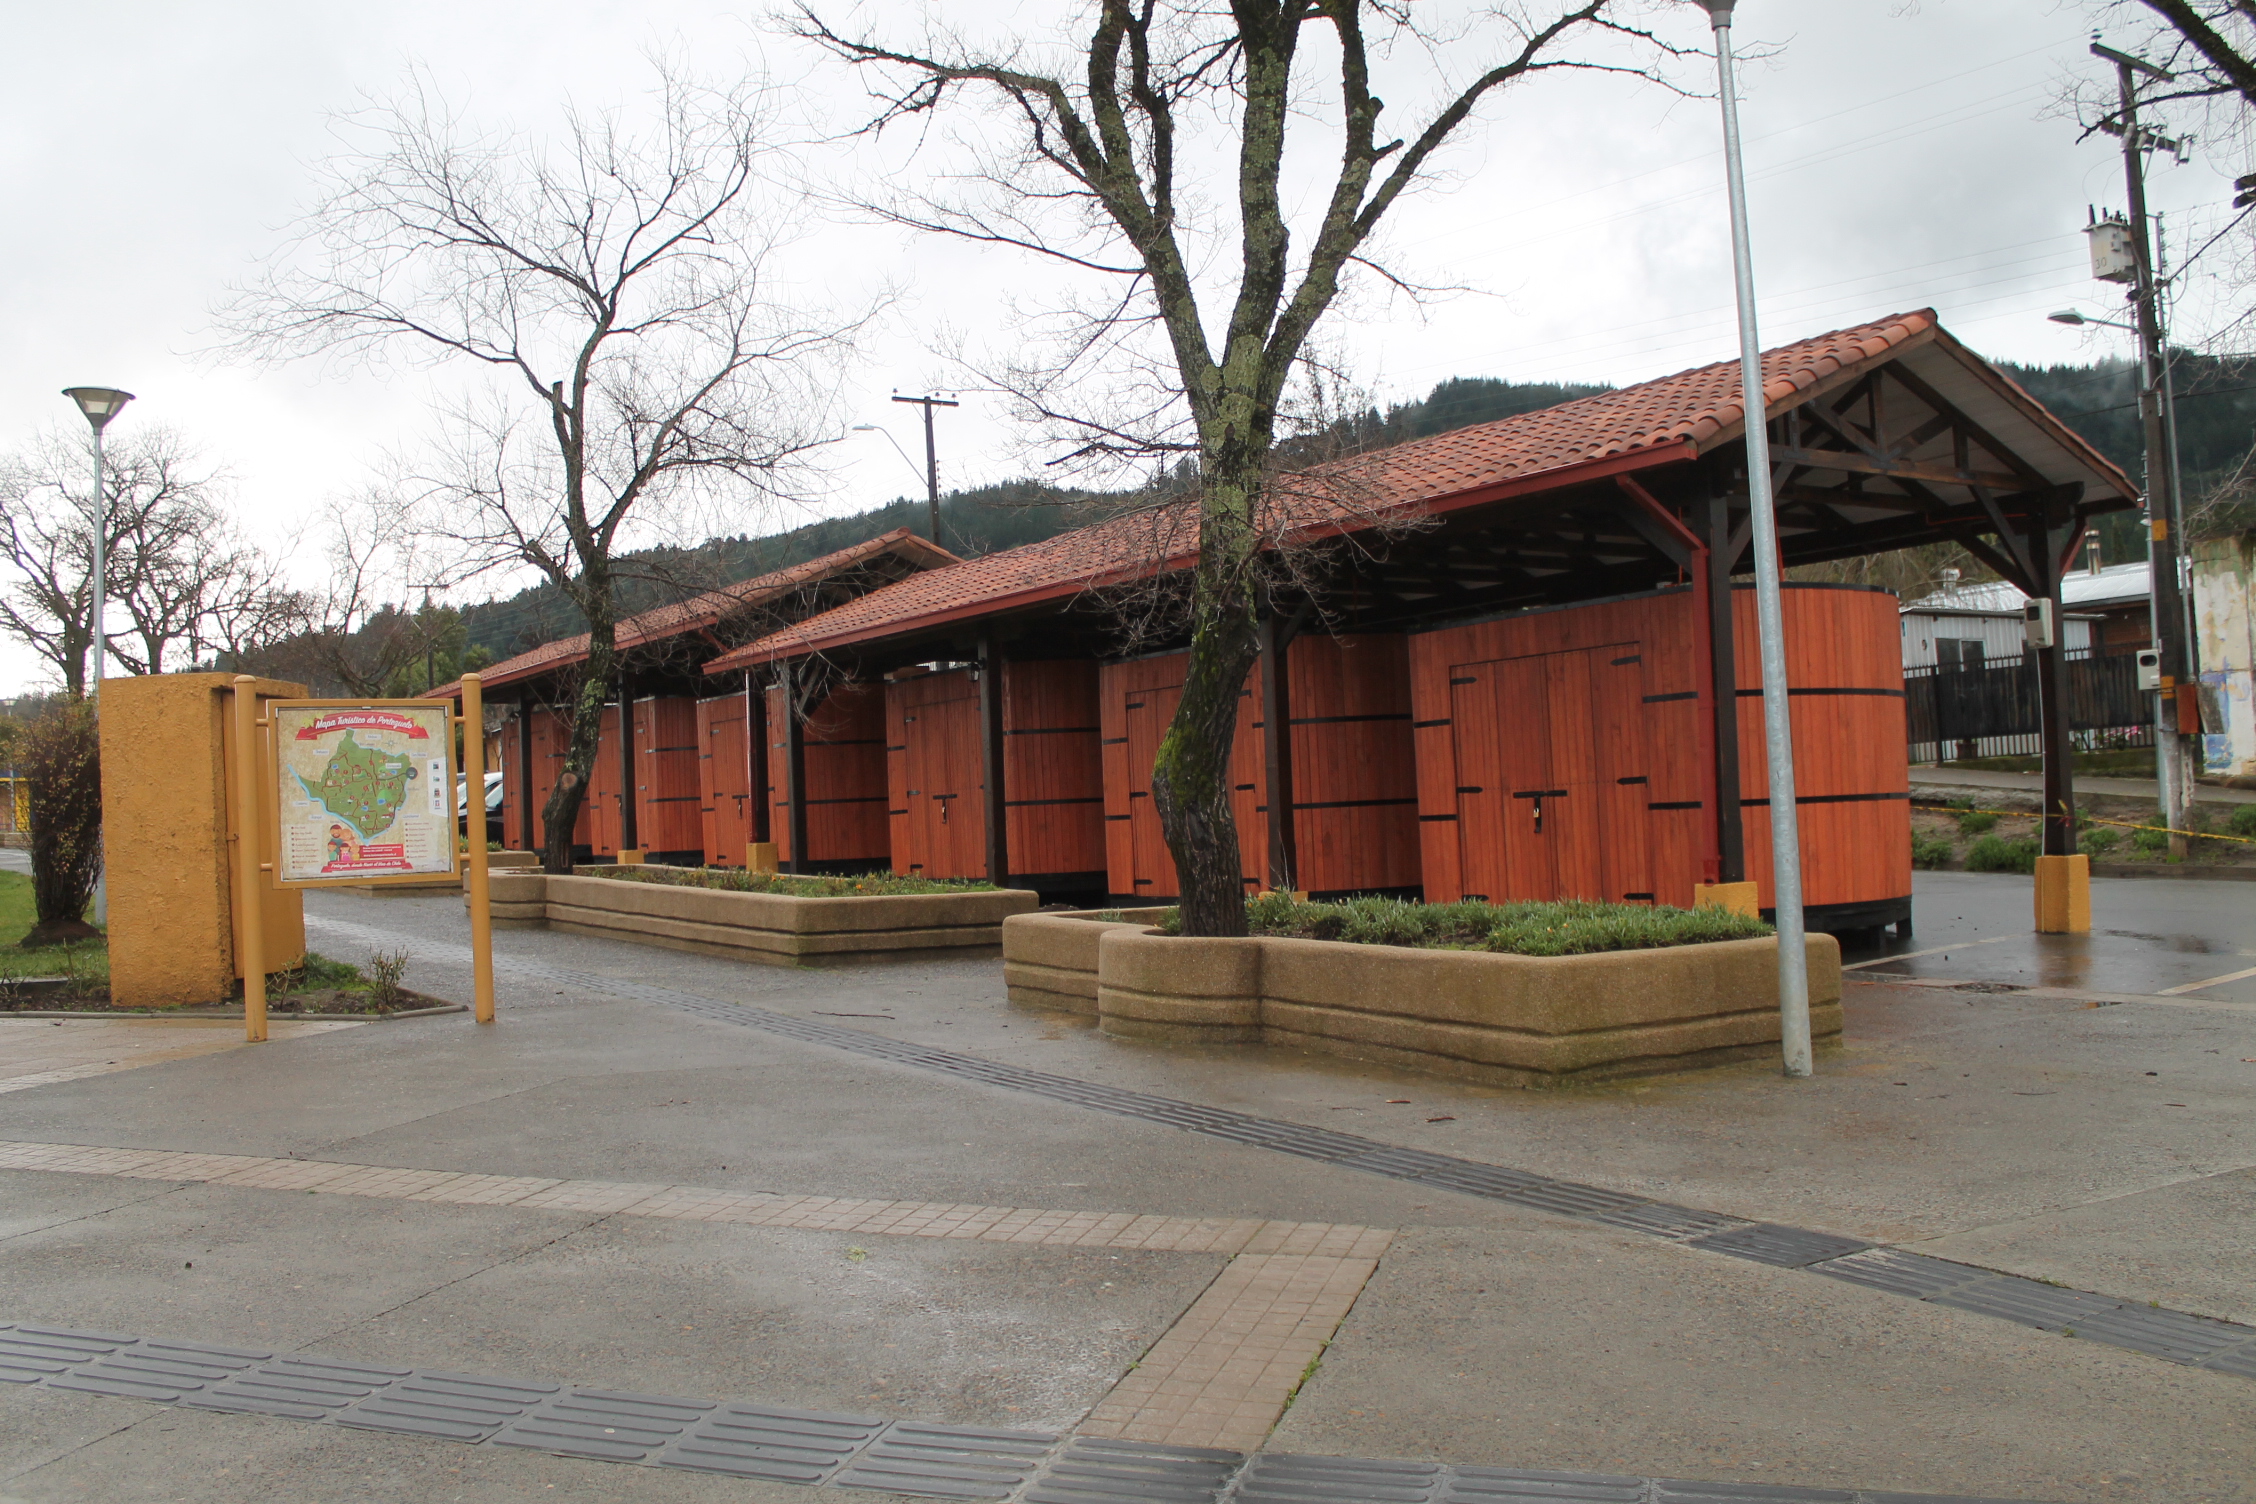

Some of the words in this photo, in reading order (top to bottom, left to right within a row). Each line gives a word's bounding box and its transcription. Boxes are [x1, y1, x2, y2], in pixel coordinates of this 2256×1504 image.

[2096, 257, 2106, 270] 30
[315, 719, 336, 729] Mapa
[366, 715, 376, 724] de
[377, 715, 413, 729] Portezuelo
